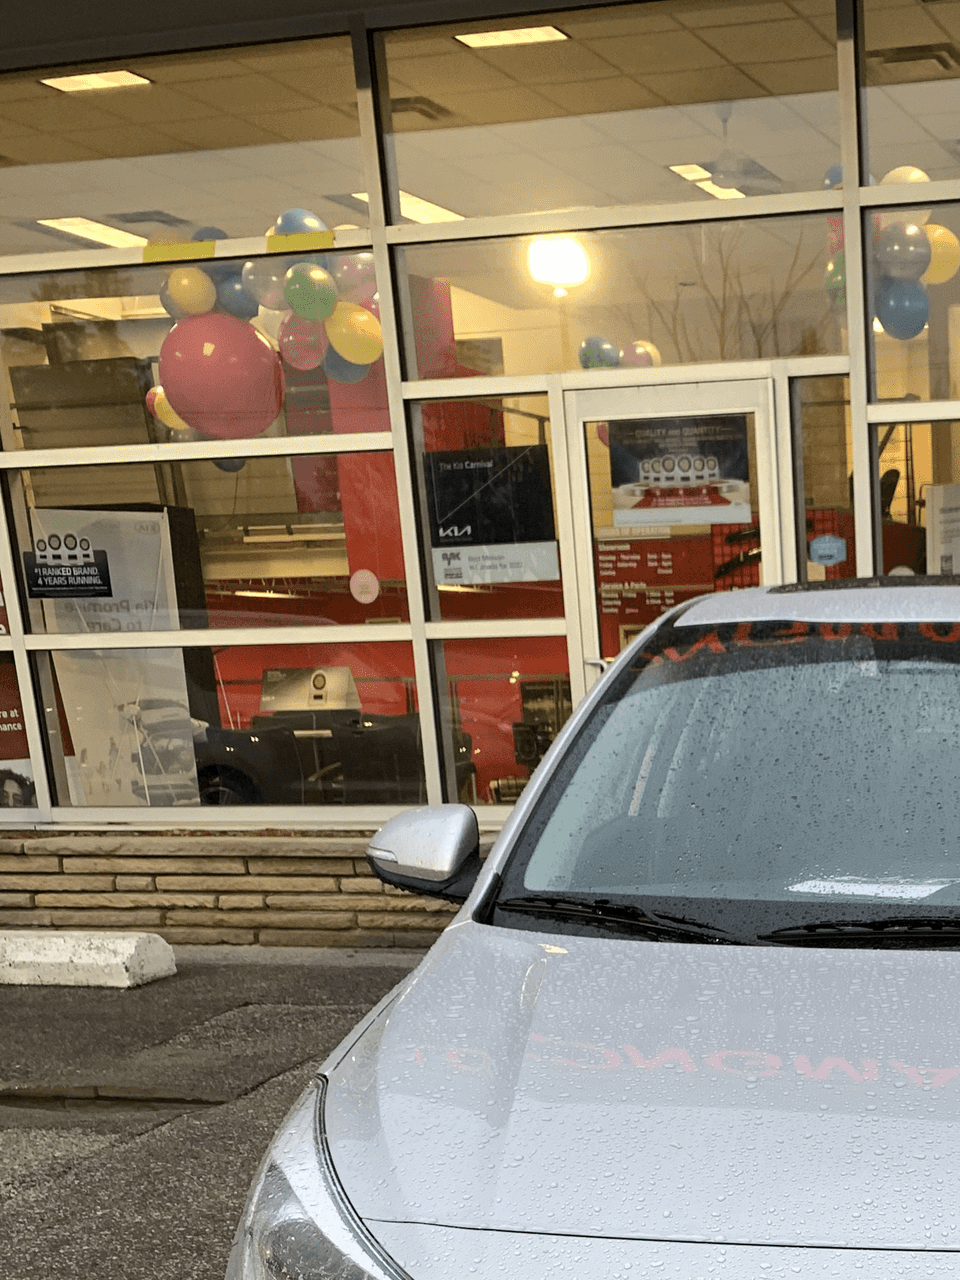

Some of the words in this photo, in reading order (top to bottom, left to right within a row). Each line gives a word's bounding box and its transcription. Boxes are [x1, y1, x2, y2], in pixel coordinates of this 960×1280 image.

[464, 460, 494, 470] Carnival
[439, 525, 472, 537] KIA
[42, 566, 72, 576] RANKED
[73, 565, 100, 575] BRAND.
[37, 576, 43, 586] 4
[43, 576, 67, 586] YEARS
[67, 575, 103, 585] RUNNING.
[9, 708, 20, 718] at
